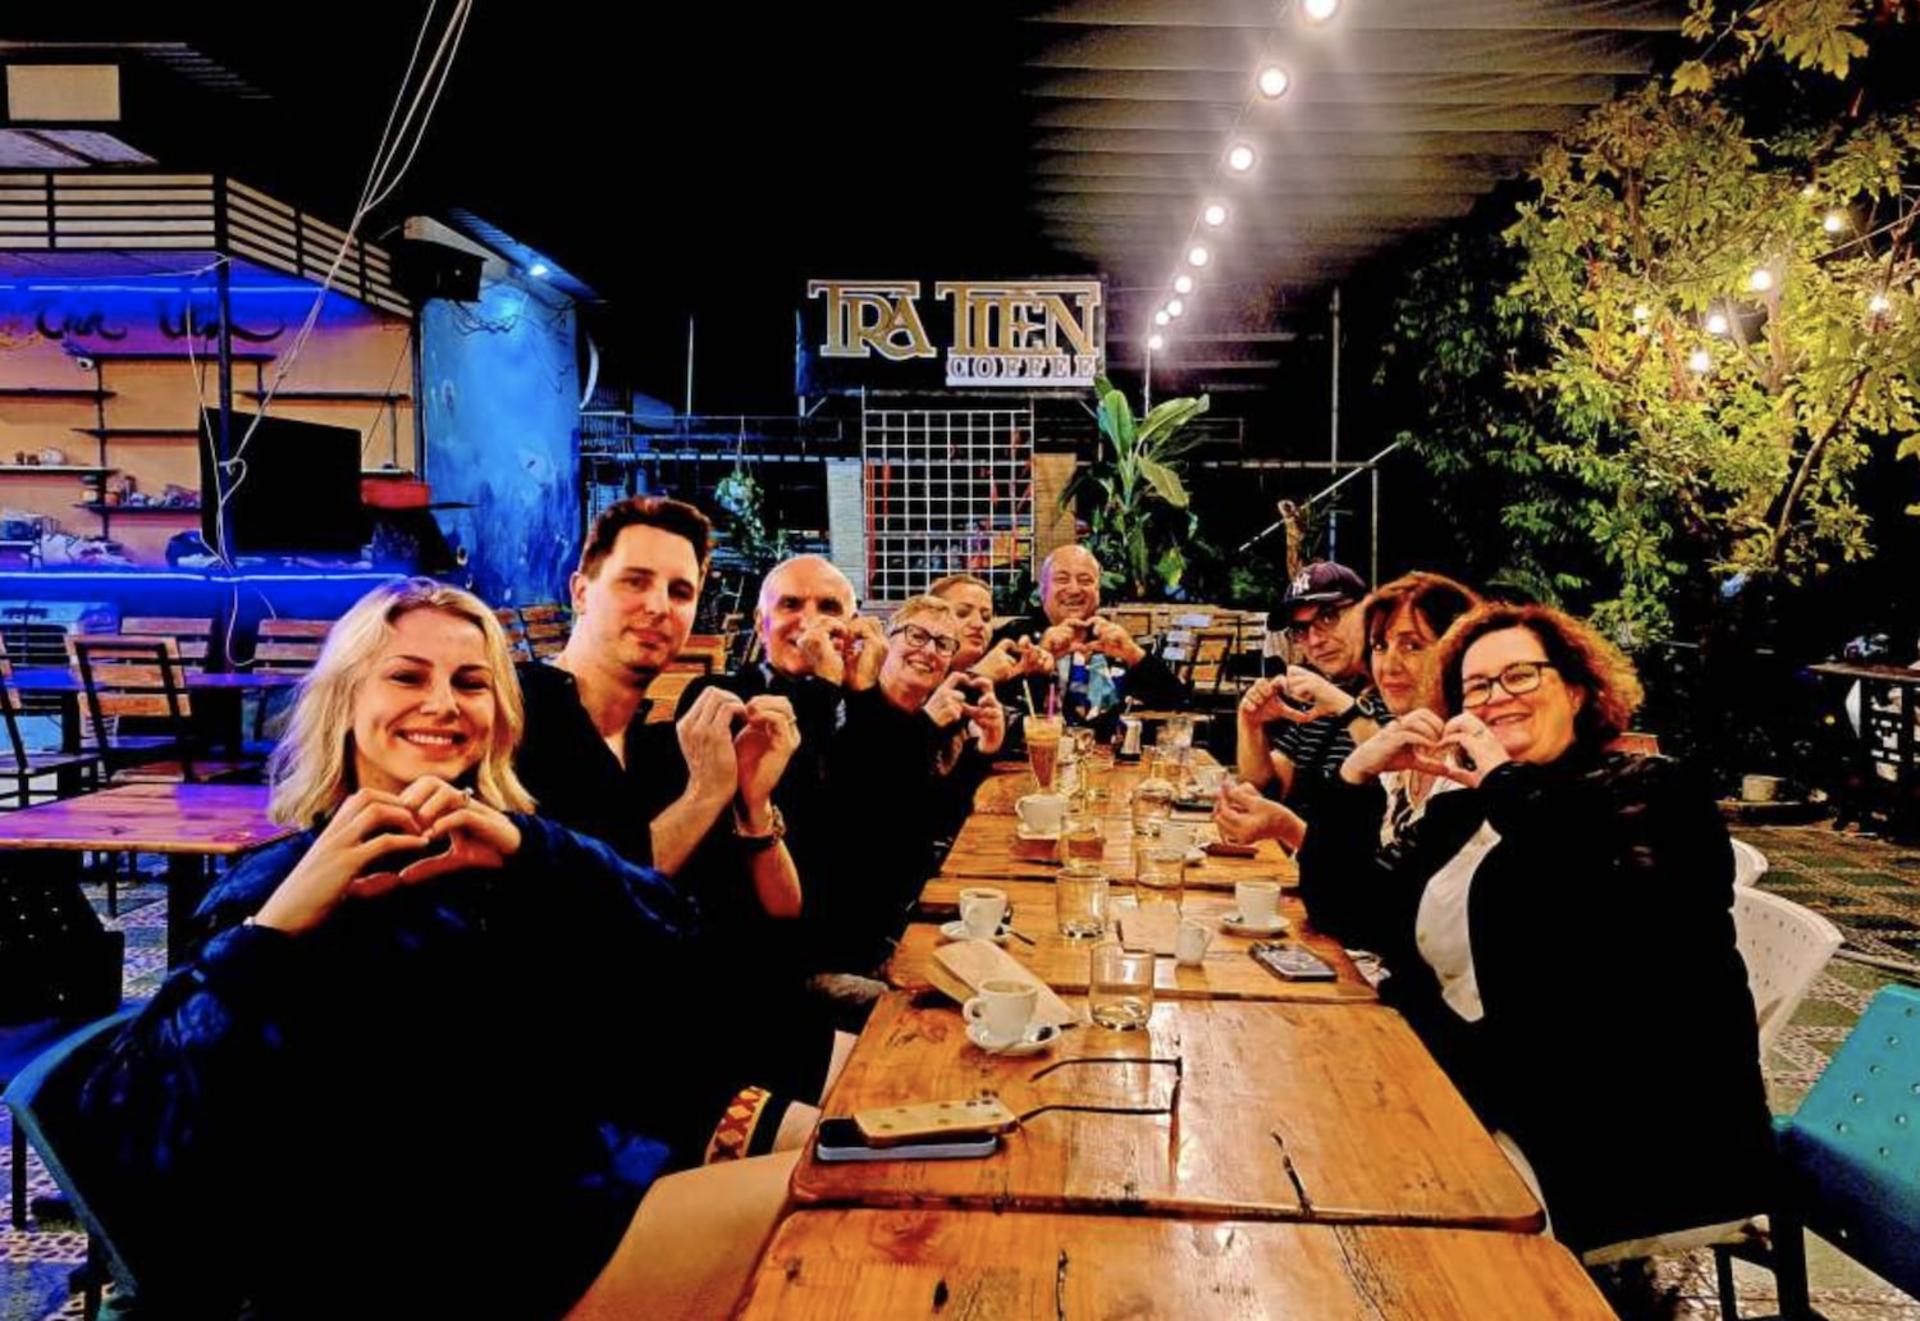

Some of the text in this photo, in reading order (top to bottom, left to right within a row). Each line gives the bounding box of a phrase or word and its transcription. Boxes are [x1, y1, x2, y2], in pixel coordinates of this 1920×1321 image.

[807, 279, 1101, 360] TRA TIEN
[949, 356, 1096, 378] COFFEE
